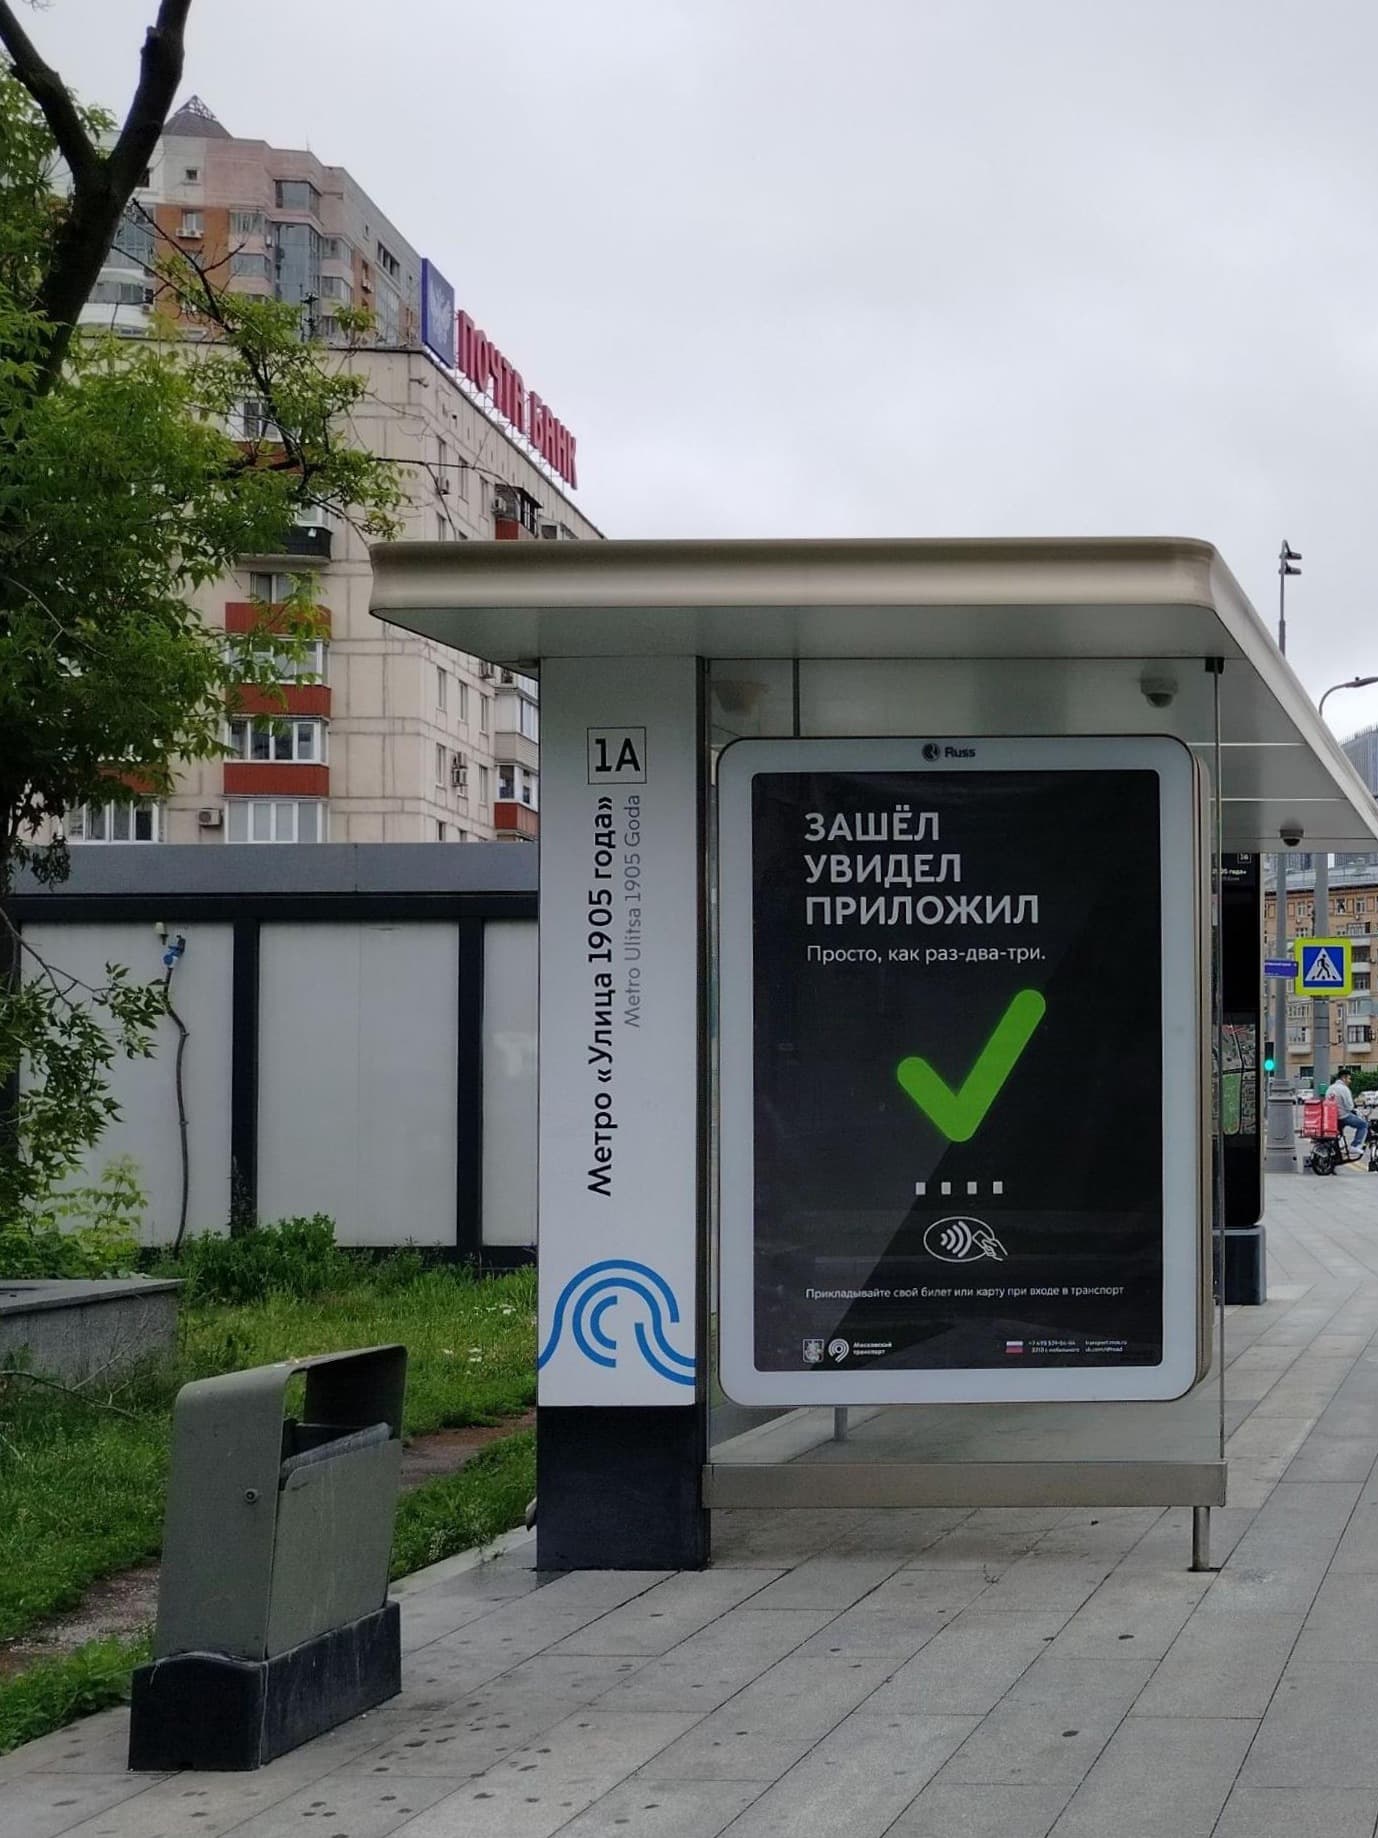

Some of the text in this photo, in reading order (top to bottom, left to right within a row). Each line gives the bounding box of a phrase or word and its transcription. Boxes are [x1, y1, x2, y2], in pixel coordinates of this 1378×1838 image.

[458, 310, 578, 490] ПОЧТА БАНК
[944, 746, 976, 758] Russ
[804, 804, 940, 841] ЗАШЁЛ
[804, 853, 962, 888] УВИДЕЛ
[624, 794, 641, 1027] Metro Ulitsa 1905 Goda
[805, 894, 1039, 925] ПРИЛОЖИЛ
[806, 945, 1046, 965] Просто, как раз-два-три.
[587, 795, 618, 1197] Метро «Улица 1905 года»
[805, 1285, 1124, 1300] Прикладывайте свой билет или карту при входе в транспорт
